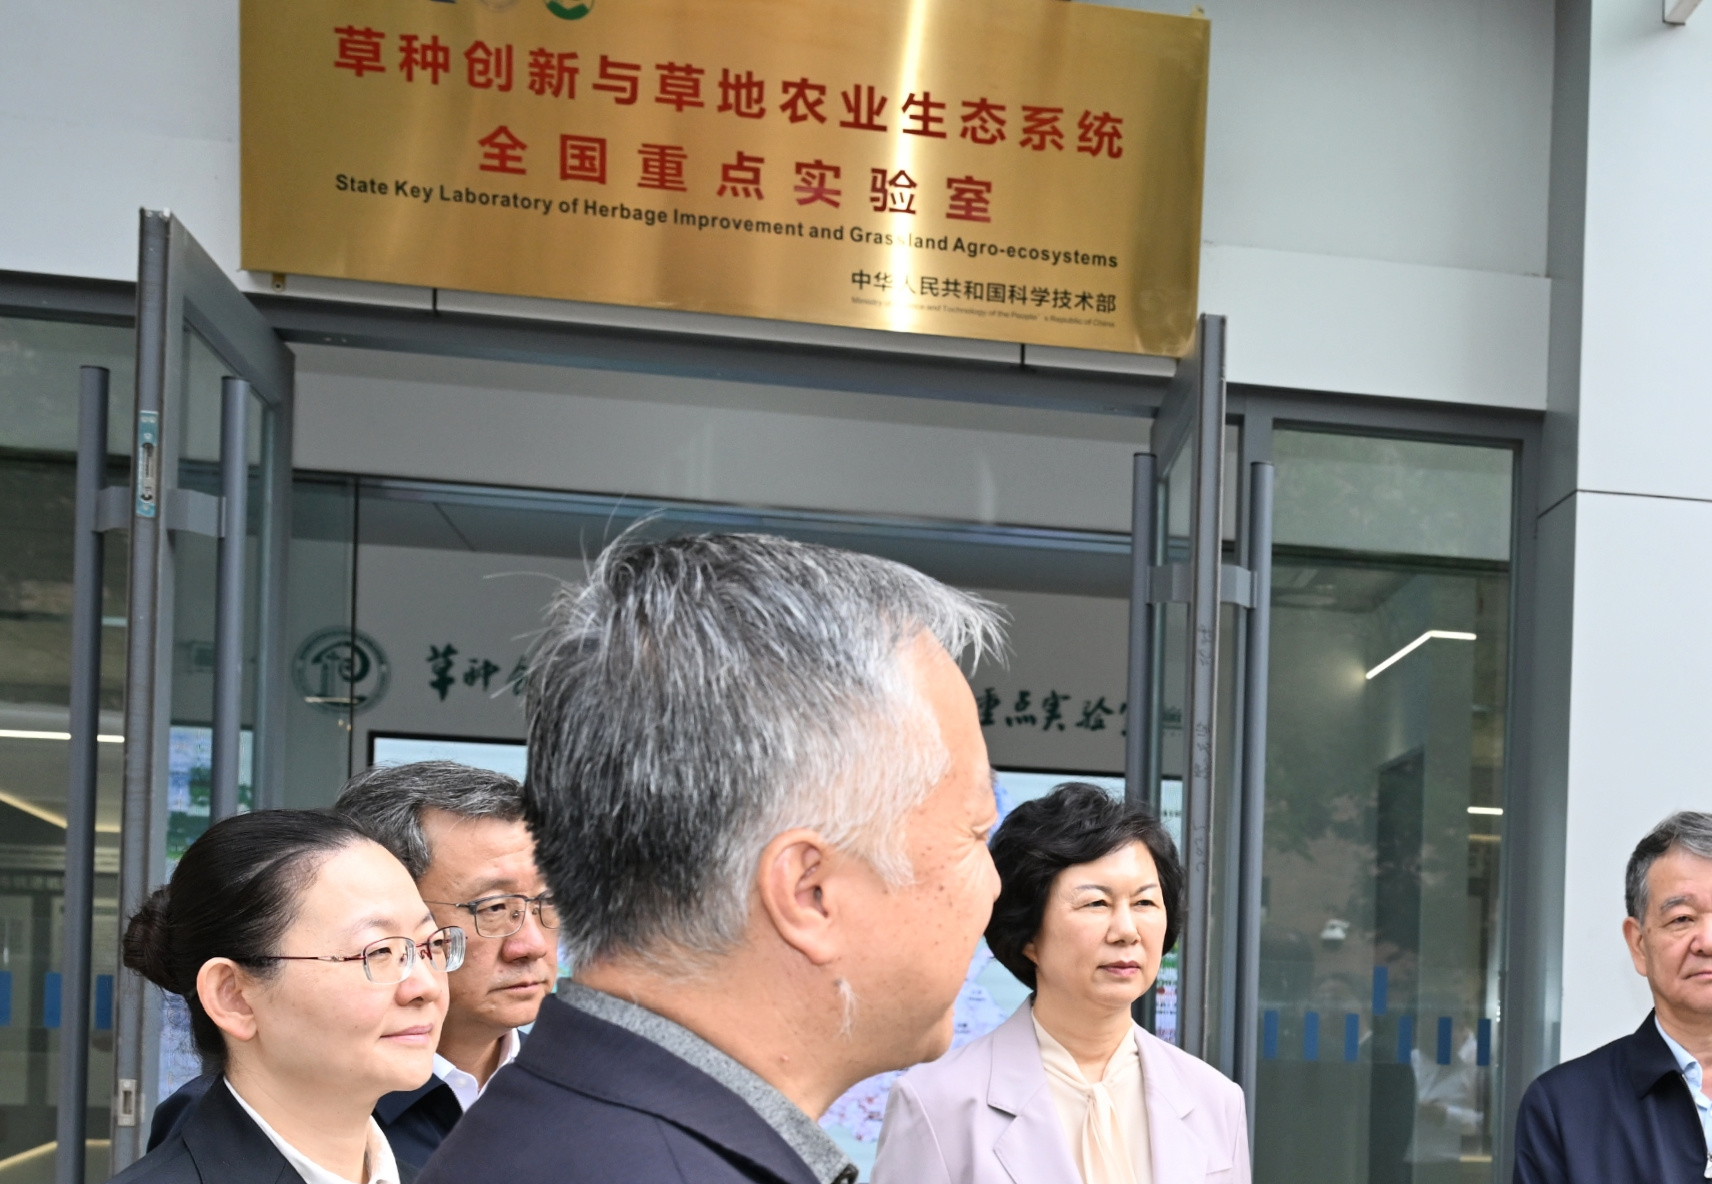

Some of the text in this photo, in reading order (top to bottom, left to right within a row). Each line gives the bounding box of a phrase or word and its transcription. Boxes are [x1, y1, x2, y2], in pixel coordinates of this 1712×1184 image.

[334, 25, 1123, 159] 草种创新与草地农业生态系统
[335, 174, 388, 195] State
[395, 180, 433, 203] Key
[440, 185, 552, 215] Laboratory
[558, 198, 578, 214] of
[584, 199, 668, 226] Herbage
[674, 209, 804, 237] Improvement
[809, 226, 844, 241] and
[953, 237, 1118, 268] Agro-ecosystems
[477, 126, 992, 223] 全国重点实验室
[852, 269, 1116, 313] 中华人民共和国科学技术部
[978, 687, 1127, 736] 重点实验
